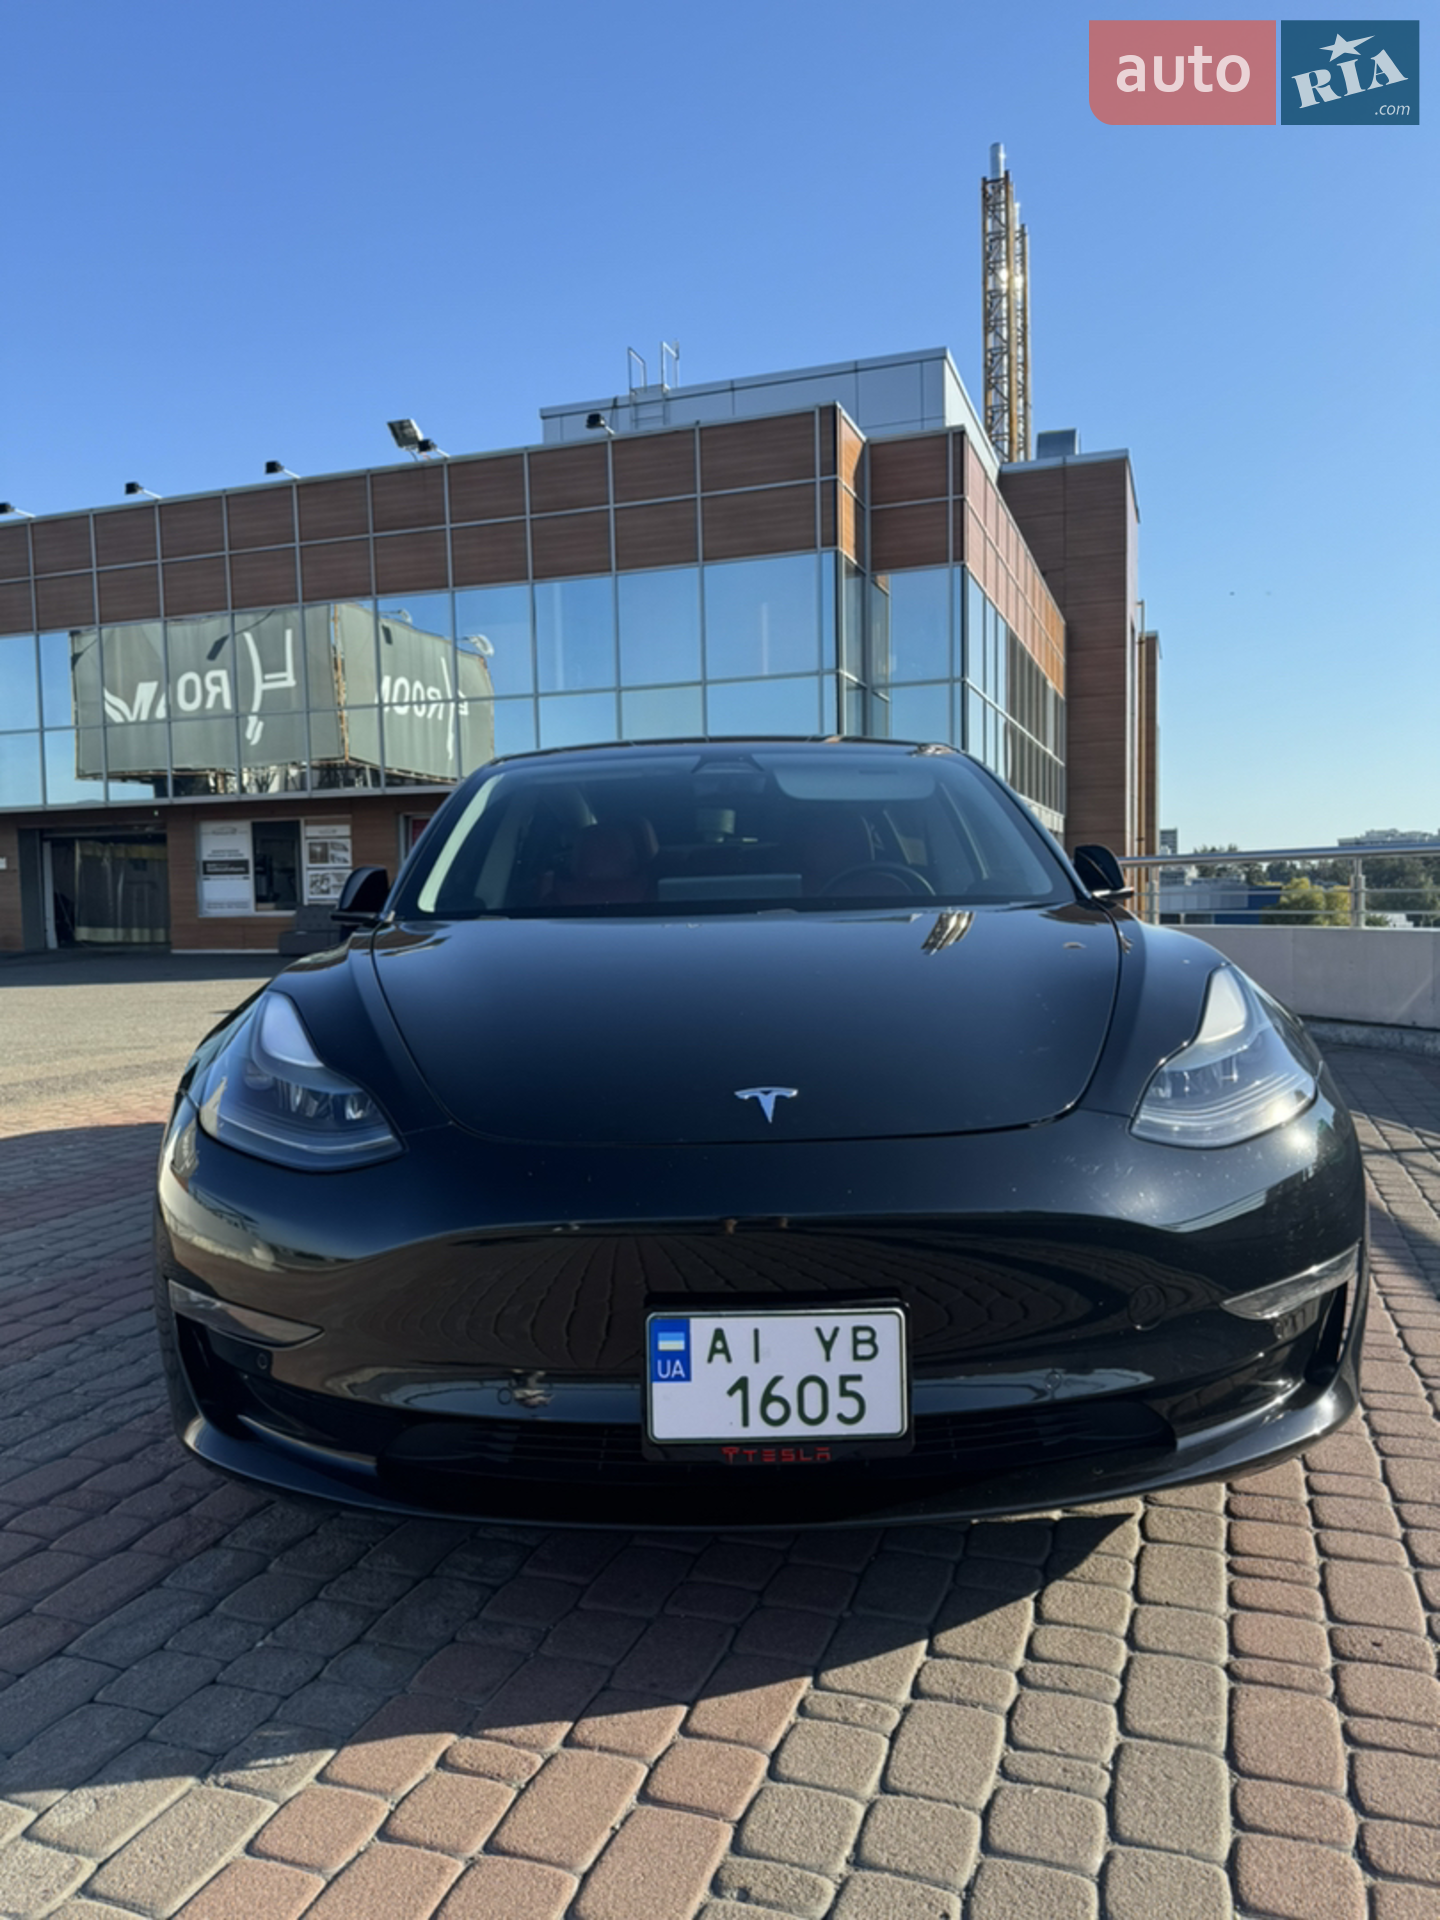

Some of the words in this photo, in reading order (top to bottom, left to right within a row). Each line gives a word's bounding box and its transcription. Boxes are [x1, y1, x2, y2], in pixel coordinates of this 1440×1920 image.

[706, 1327, 760, 1364] AI
[814, 1325, 879, 1362] YB
[656, 1359, 686, 1379] UA
[726, 1374, 867, 1428] 1605
[742, 1446, 831, 1463] TESLA
